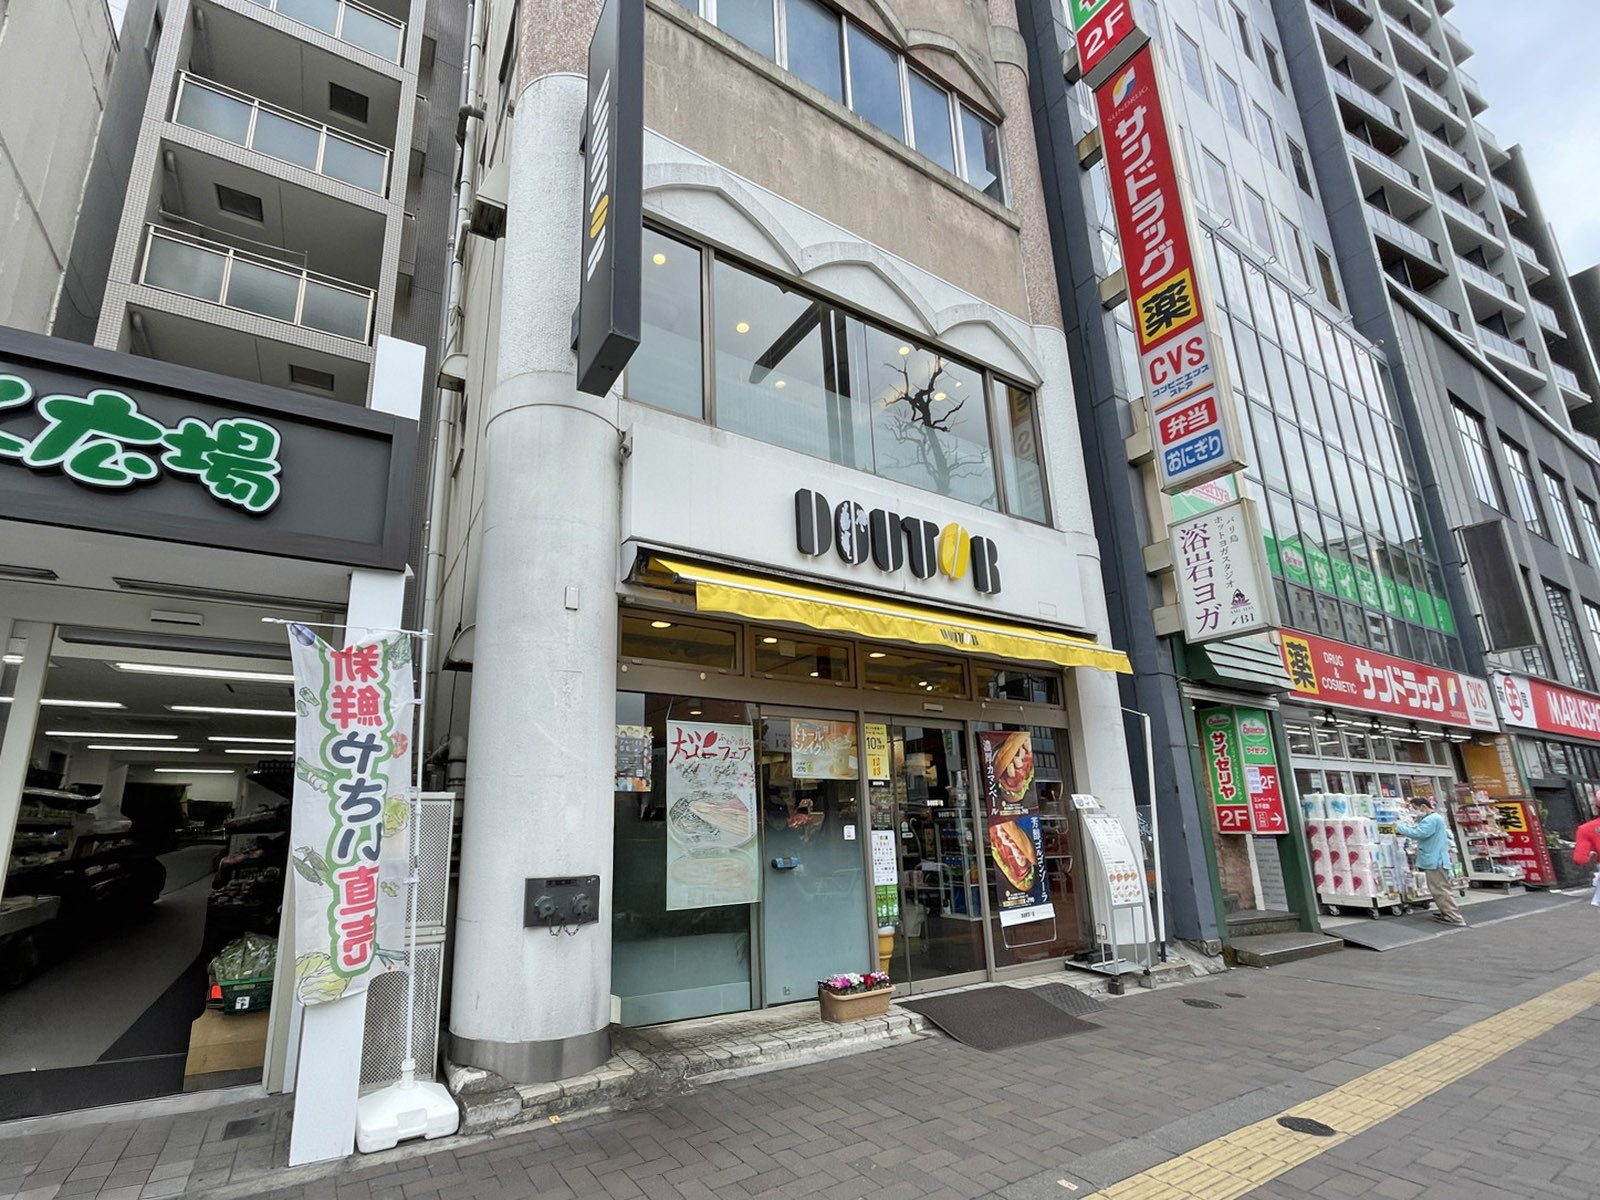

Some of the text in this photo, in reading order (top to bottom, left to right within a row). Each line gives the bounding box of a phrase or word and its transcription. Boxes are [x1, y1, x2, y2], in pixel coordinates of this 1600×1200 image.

[1084, 2, 1124, 60] 2F
[1115, 104, 1175, 289] サンドラッグ
[1142, 277, 1192, 337] 薬
[1149, 336, 1206, 386] CVS
[1152, 364, 1211, 398] コンビニエンス
[1170, 381, 1194, 398] ストア
[1167, 403, 1210, 439] 弁当
[1167, 435, 1222, 473] おにぎり
[794, 487, 1002, 596] DOUTOR
[1214, 515, 1235, 589] ホットヨガスタジオ
[1179, 522, 1222, 634] 溶岩ヨガ
[1285, 641, 1316, 689] 薬
[1322, 651, 1344, 667] DRUG
[1334, 668, 1341, 679] &
[1321, 676, 1358, 695] COSMETIC
[1355, 656, 1445, 713] サンドラッグ
[1466, 680, 1488, 711] CVS
[1210, 730, 1236, 800] サイゼリヤ
[1260, 775, 1276, 790] 2F
[1220, 809, 1248, 827] 2F
